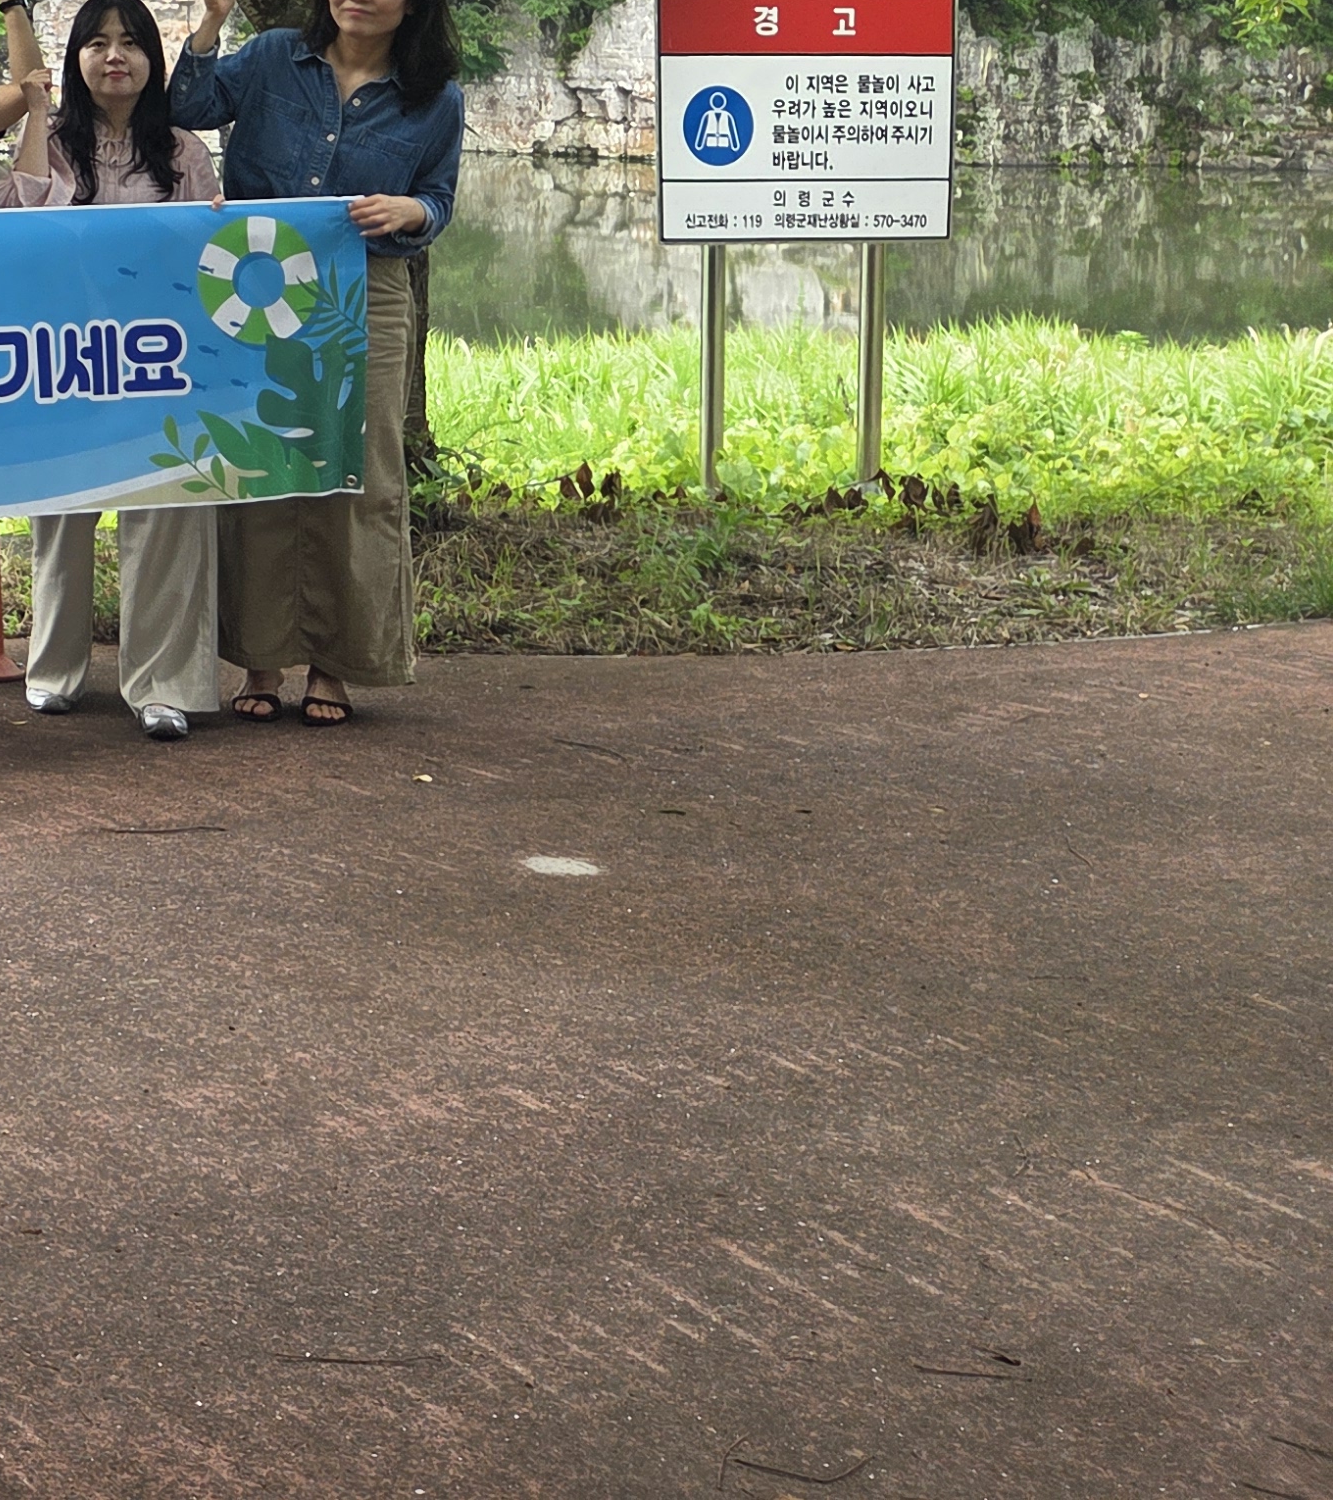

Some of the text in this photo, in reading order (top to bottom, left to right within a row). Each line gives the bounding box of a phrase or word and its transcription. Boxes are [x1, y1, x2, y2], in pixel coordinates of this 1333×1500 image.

[785, 74, 936, 95] 이 지역은 물놀이 사고
[771, 98, 933, 120] 우려가 높은 지역이오니
[771, 124, 933, 145] 물놀이시 주의하여 주시기
[772, 150, 834, 171] 바랍니다.
[742, 214, 763, 228] 119
[873, 214, 927, 228] 570-3470
